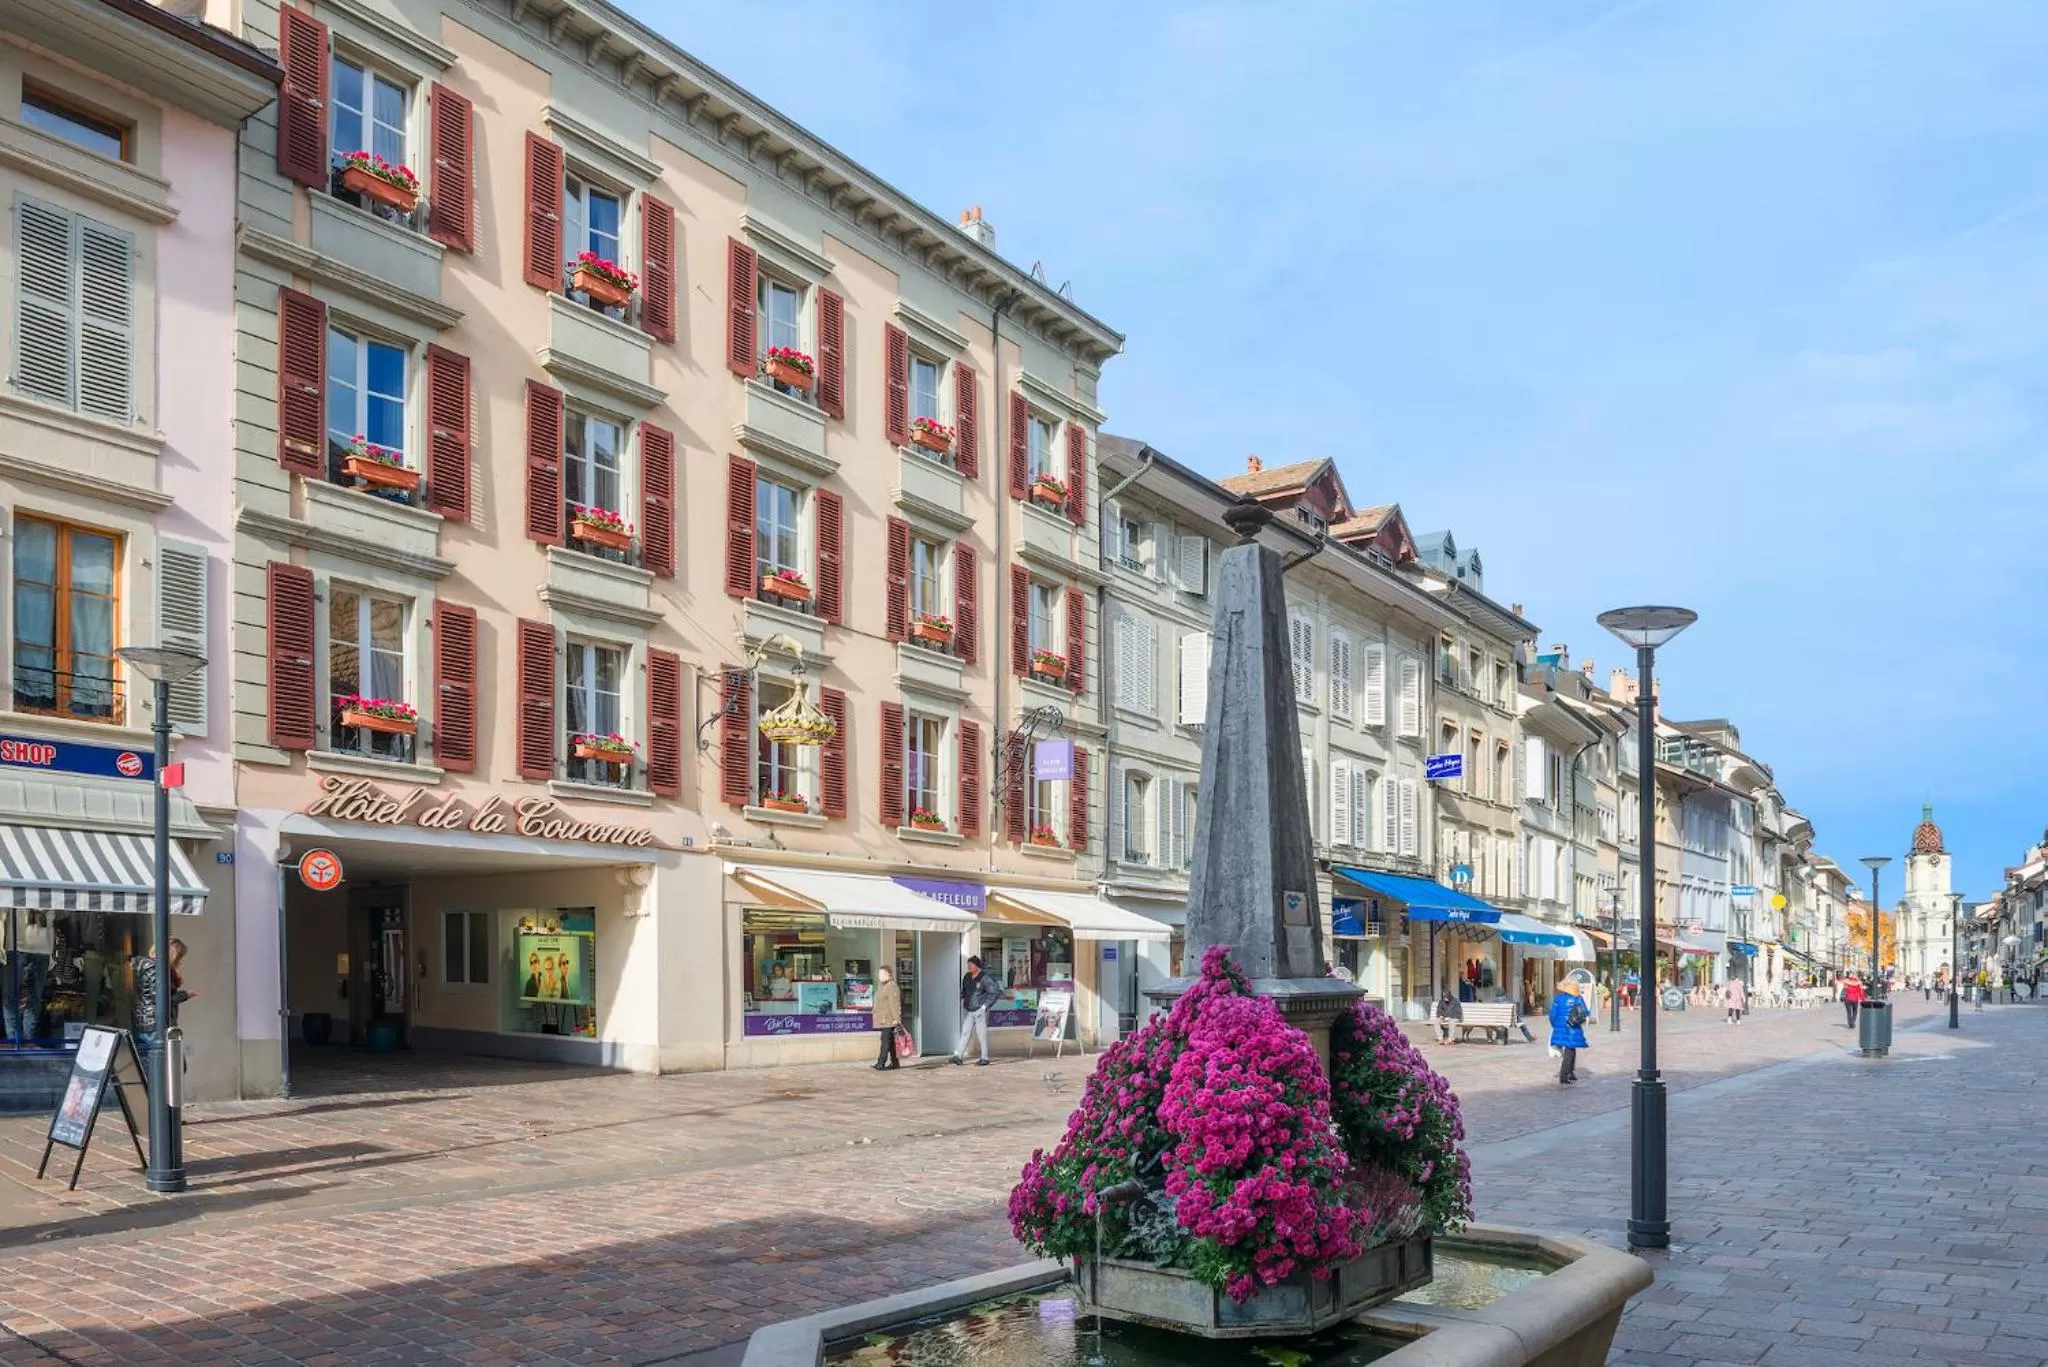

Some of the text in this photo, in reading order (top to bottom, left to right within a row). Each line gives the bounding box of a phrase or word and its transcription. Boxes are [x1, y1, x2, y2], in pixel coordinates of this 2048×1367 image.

[0, 740, 56, 765] SHOP
[308, 774, 653, 848] Hôtel de la Couronne
[219, 853, 233, 863] 90
